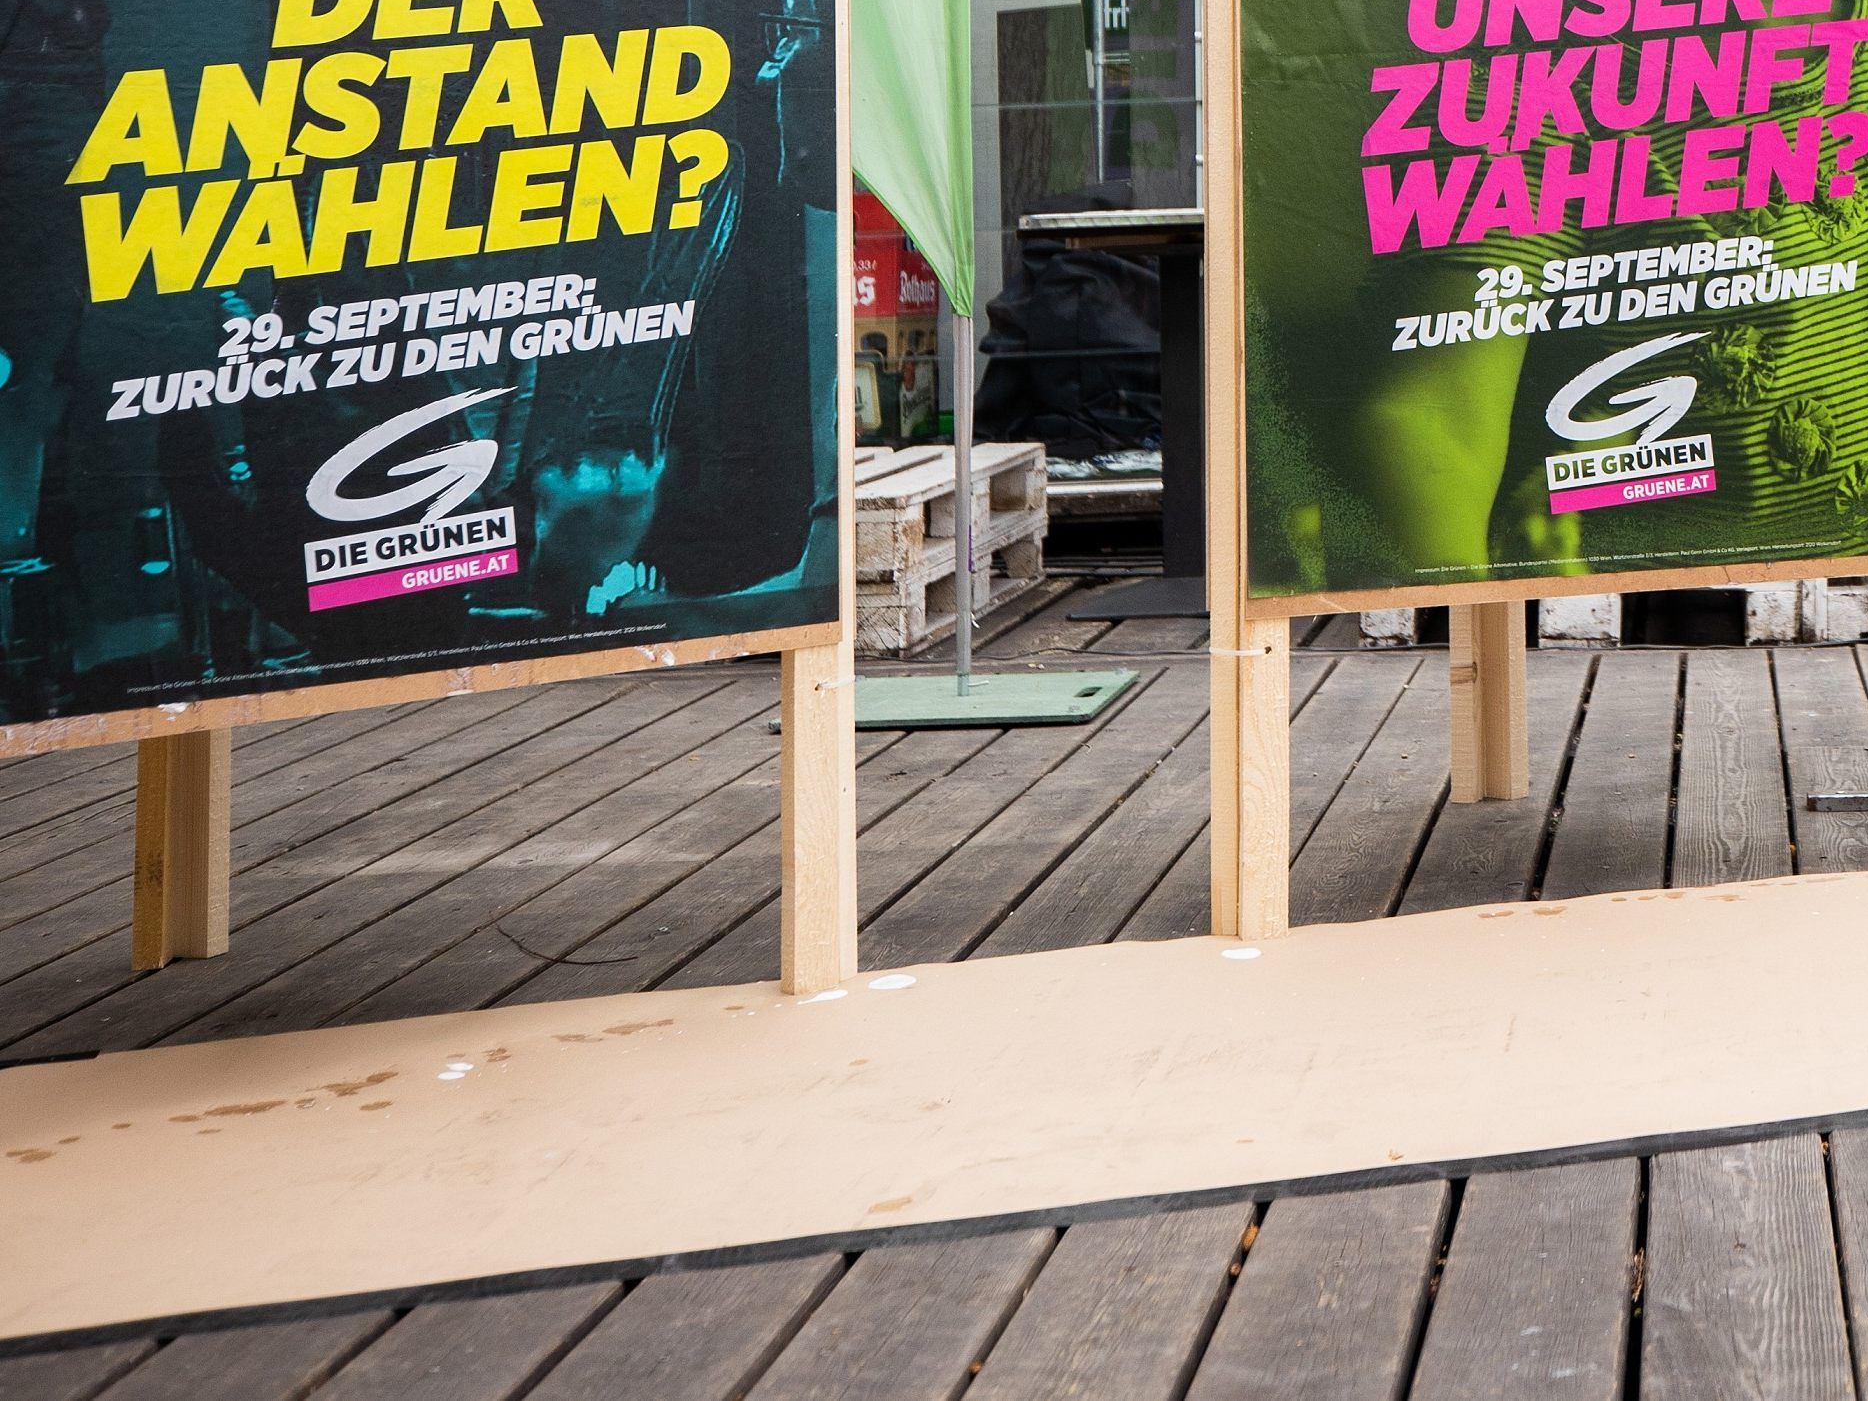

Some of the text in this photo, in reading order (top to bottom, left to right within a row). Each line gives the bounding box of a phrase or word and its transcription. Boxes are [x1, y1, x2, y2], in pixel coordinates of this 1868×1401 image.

[66, 26, 731, 184] ANSTAND
[80, 128, 729, 303] WÄHLEN?
[1391, 260, 1859, 351] ZURÜCK ZU DEN GRÜNEN
[1474, 236, 1775, 302] 29. SEPTEMBER:
[218, 274, 597, 359] 29. SEPTEMBER:
[106, 300, 696, 421] ZURÜCK ZU DEN GRÜNEN
[1553, 442, 1708, 482] DIE GRÜNEN
[1622, 474, 1710, 501] GRUENE.AT
[314, 516, 508, 573] DIE GRÜNEN
[402, 555, 509, 588] GRUENE.AT
